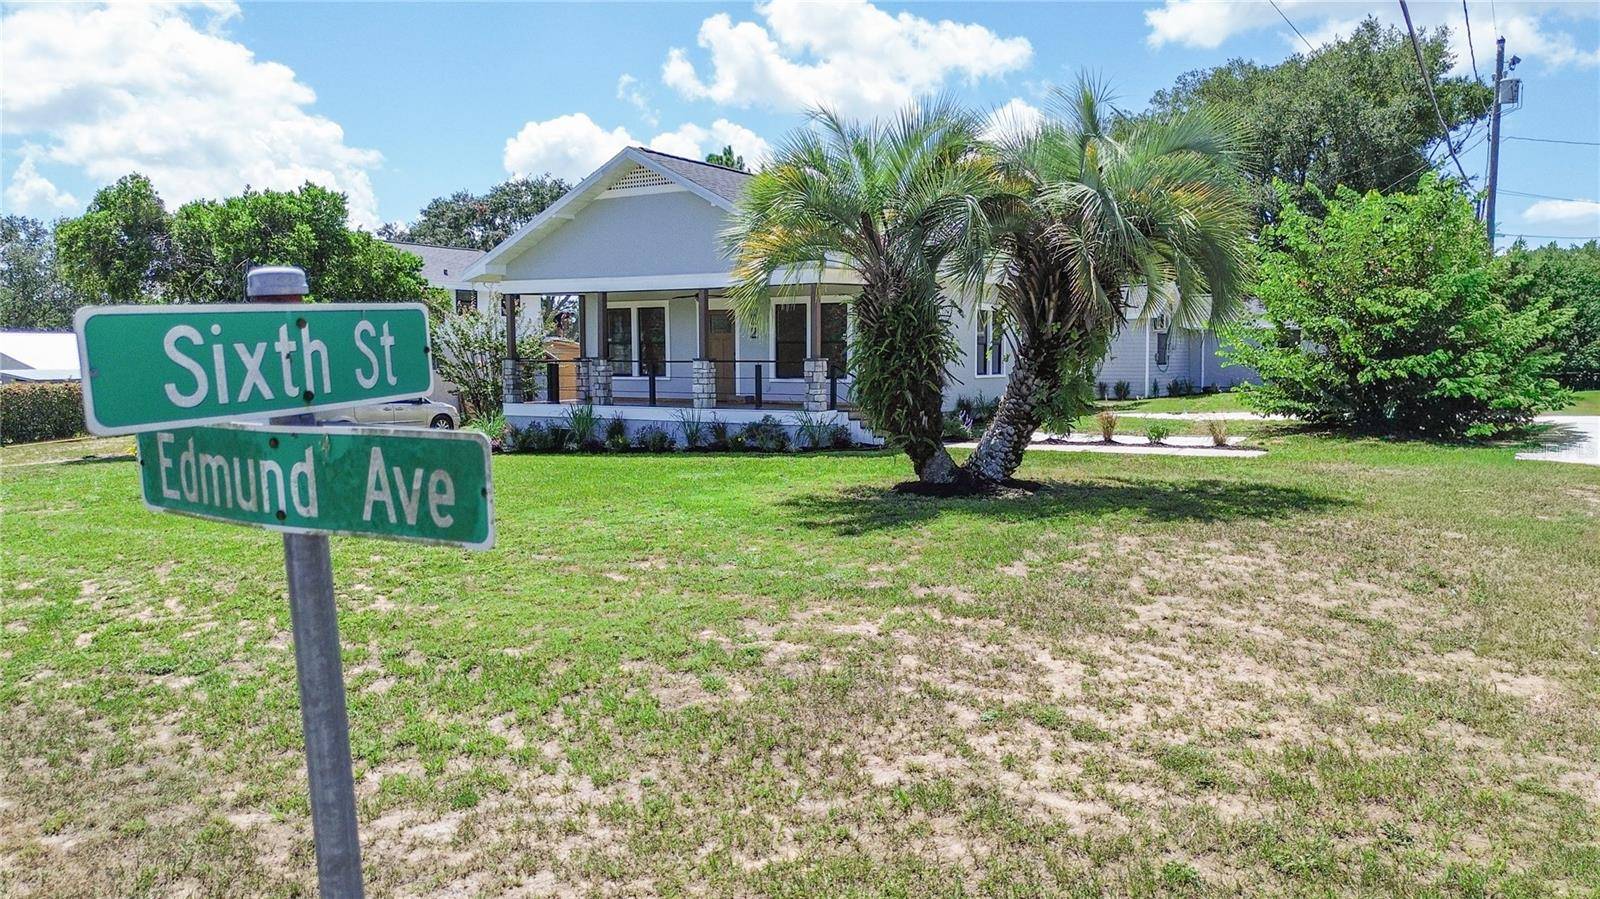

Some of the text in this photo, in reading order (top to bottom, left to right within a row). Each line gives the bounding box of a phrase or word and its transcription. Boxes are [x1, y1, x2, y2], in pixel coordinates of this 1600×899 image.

[163, 319, 398, 408] Sixth St
[157, 432, 456, 528] Edmund Ave
